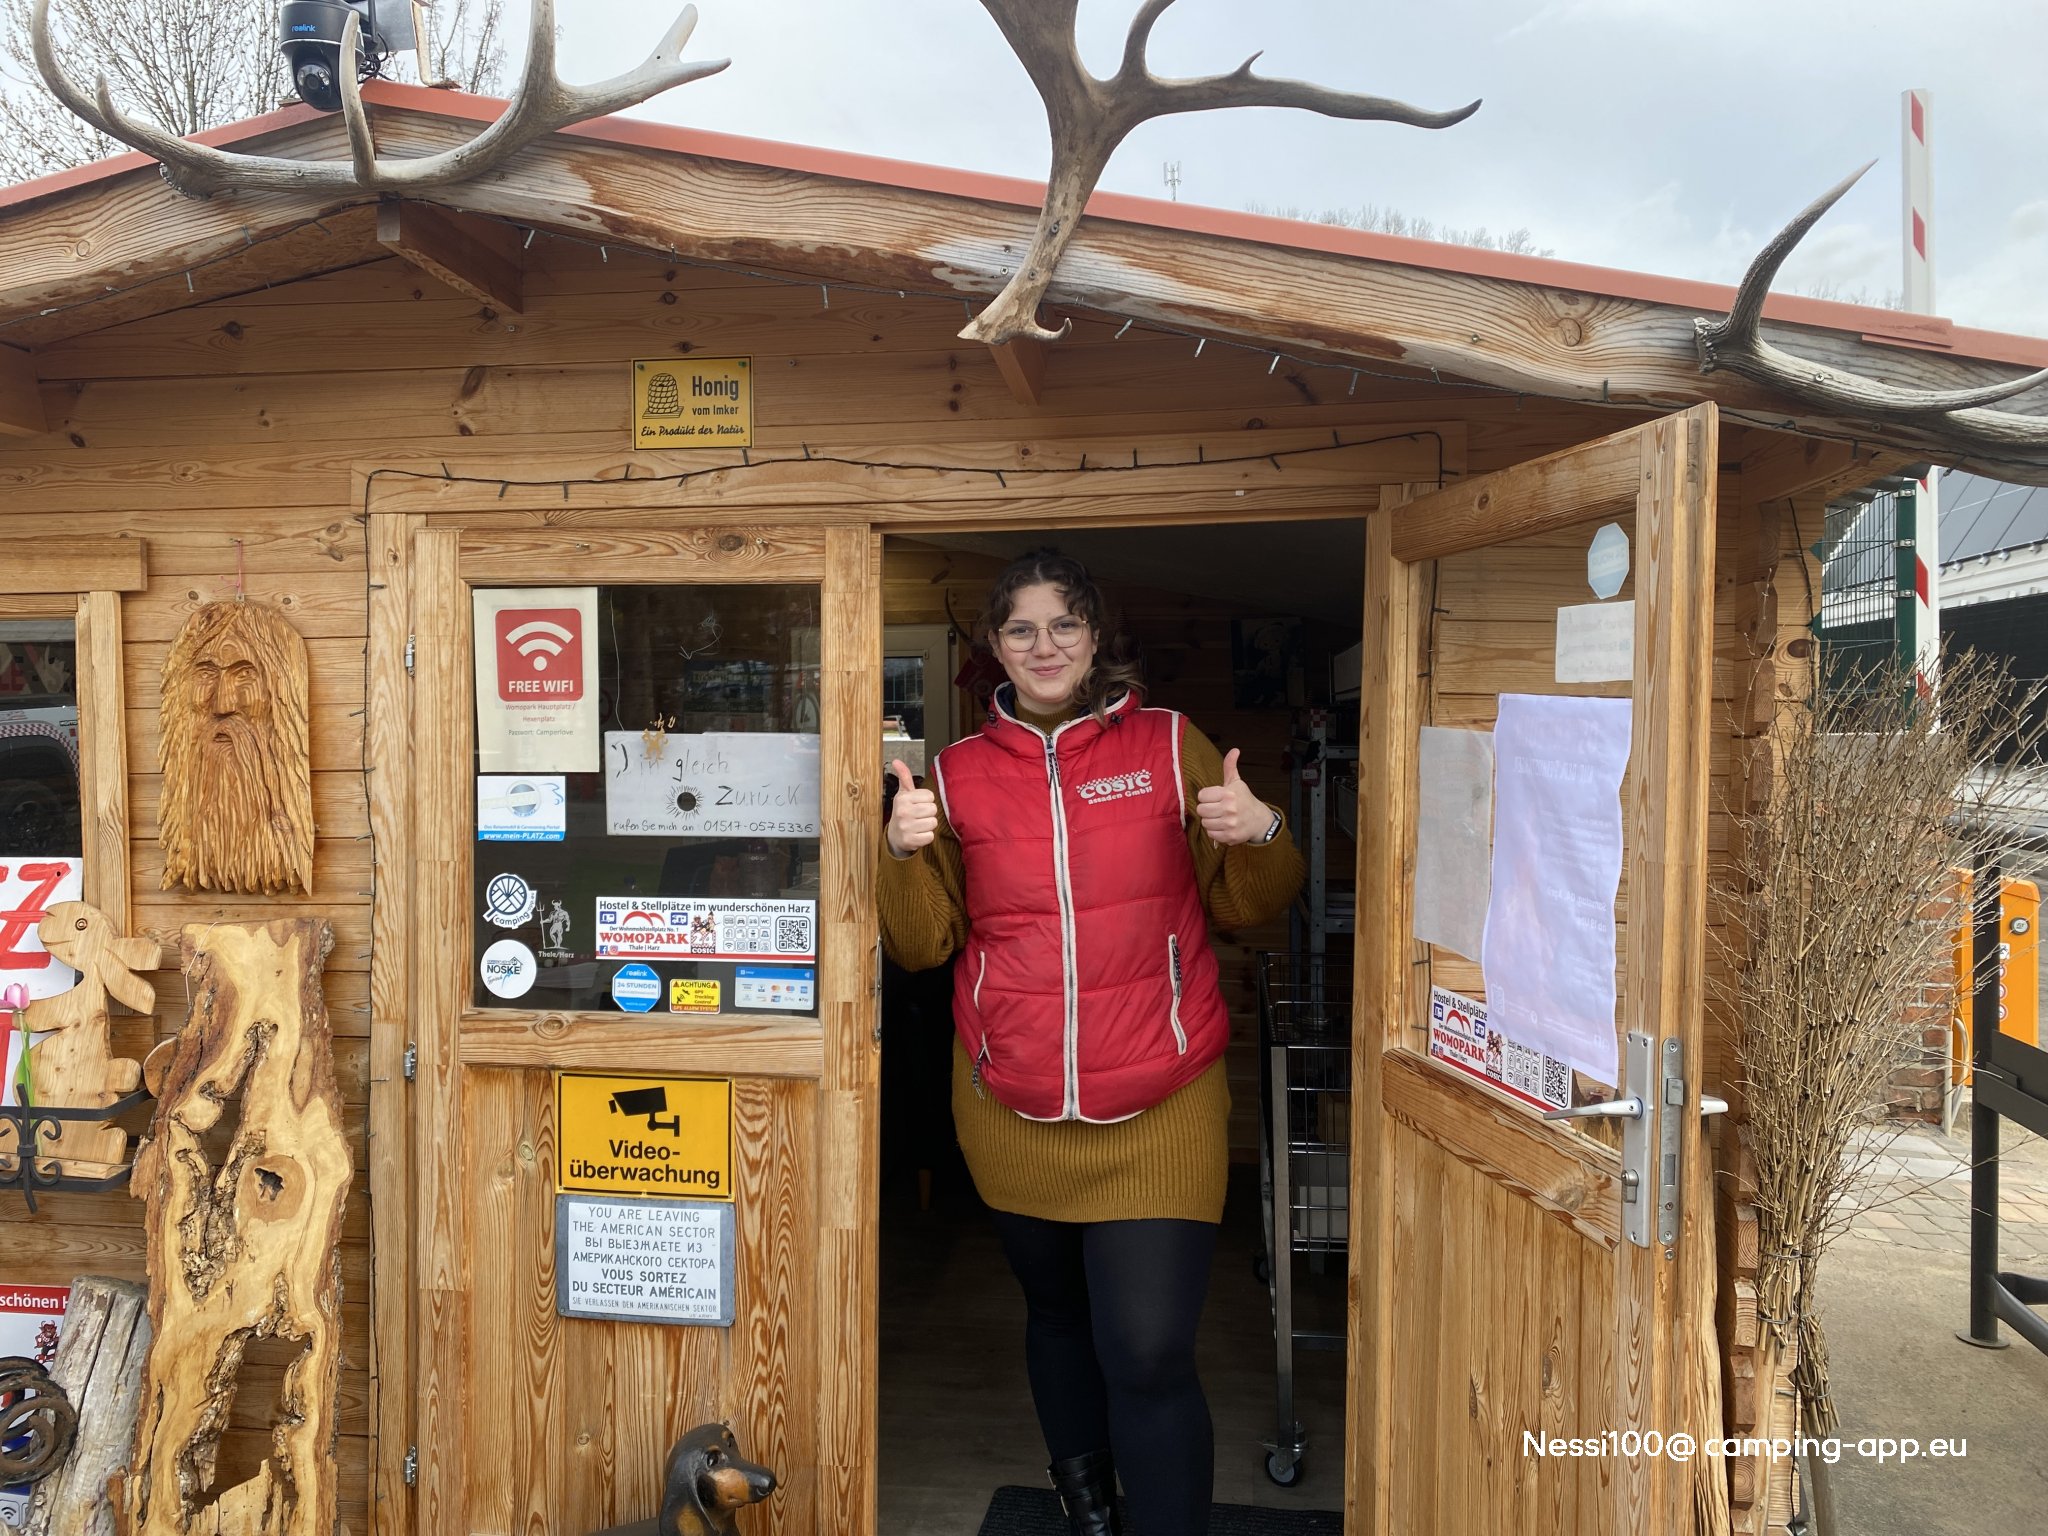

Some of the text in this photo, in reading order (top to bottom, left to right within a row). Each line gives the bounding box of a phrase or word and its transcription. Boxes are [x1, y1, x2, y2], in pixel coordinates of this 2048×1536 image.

[692, 374, 739, 401] Honig
[692, 404, 739, 416] vom Imker
[641, 424, 745, 437] Ein Produkt der Natur
[508, 679, 574, 693] FREE WIFI
[672, 749, 729, 782] gleich
[1080, 773, 1151, 799] COSIC
[1124, 785, 1153, 798] GmbH
[641, 818, 656, 831] Sie
[658, 821, 678, 831] mich
[600, 900, 811, 914] Hostel & Stellplätze im wunderschönen Harz
[599, 932, 689, 945] WOMOPARK
[538, 950, 575, 959] Thale/Harz
[486, 964, 521, 975] NOSKE
[680, 981, 711, 989] ACHTUNG
[1433, 990, 1488, 1022] Hostel & Stellplätze
[1433, 1027, 1486, 1063] WOMOPARK
[608, 1139, 681, 1161] Video-
[569, 1158, 721, 1189] überwachung
[588, 1206, 700, 1223] YOU ARE LEAVING
[573, 1220, 716, 1239] THE AMERICAN SECTOR
[585, 1236, 703, 1253] ВЫ ВЫЕЗЖАЕТЕ ИЗ
[572, 1251, 716, 1269] АМЕРИКАНСКОГО СЕКТОРА
[601, 1268, 687, 1284] VOUS SORTEZ
[572, 1281, 717, 1300] DU SECTEUR AMÉRICAIN
[572, 1297, 717, 1313] SIE VERLASSEN DEN AMERIKANISCHEN SEKTOR
